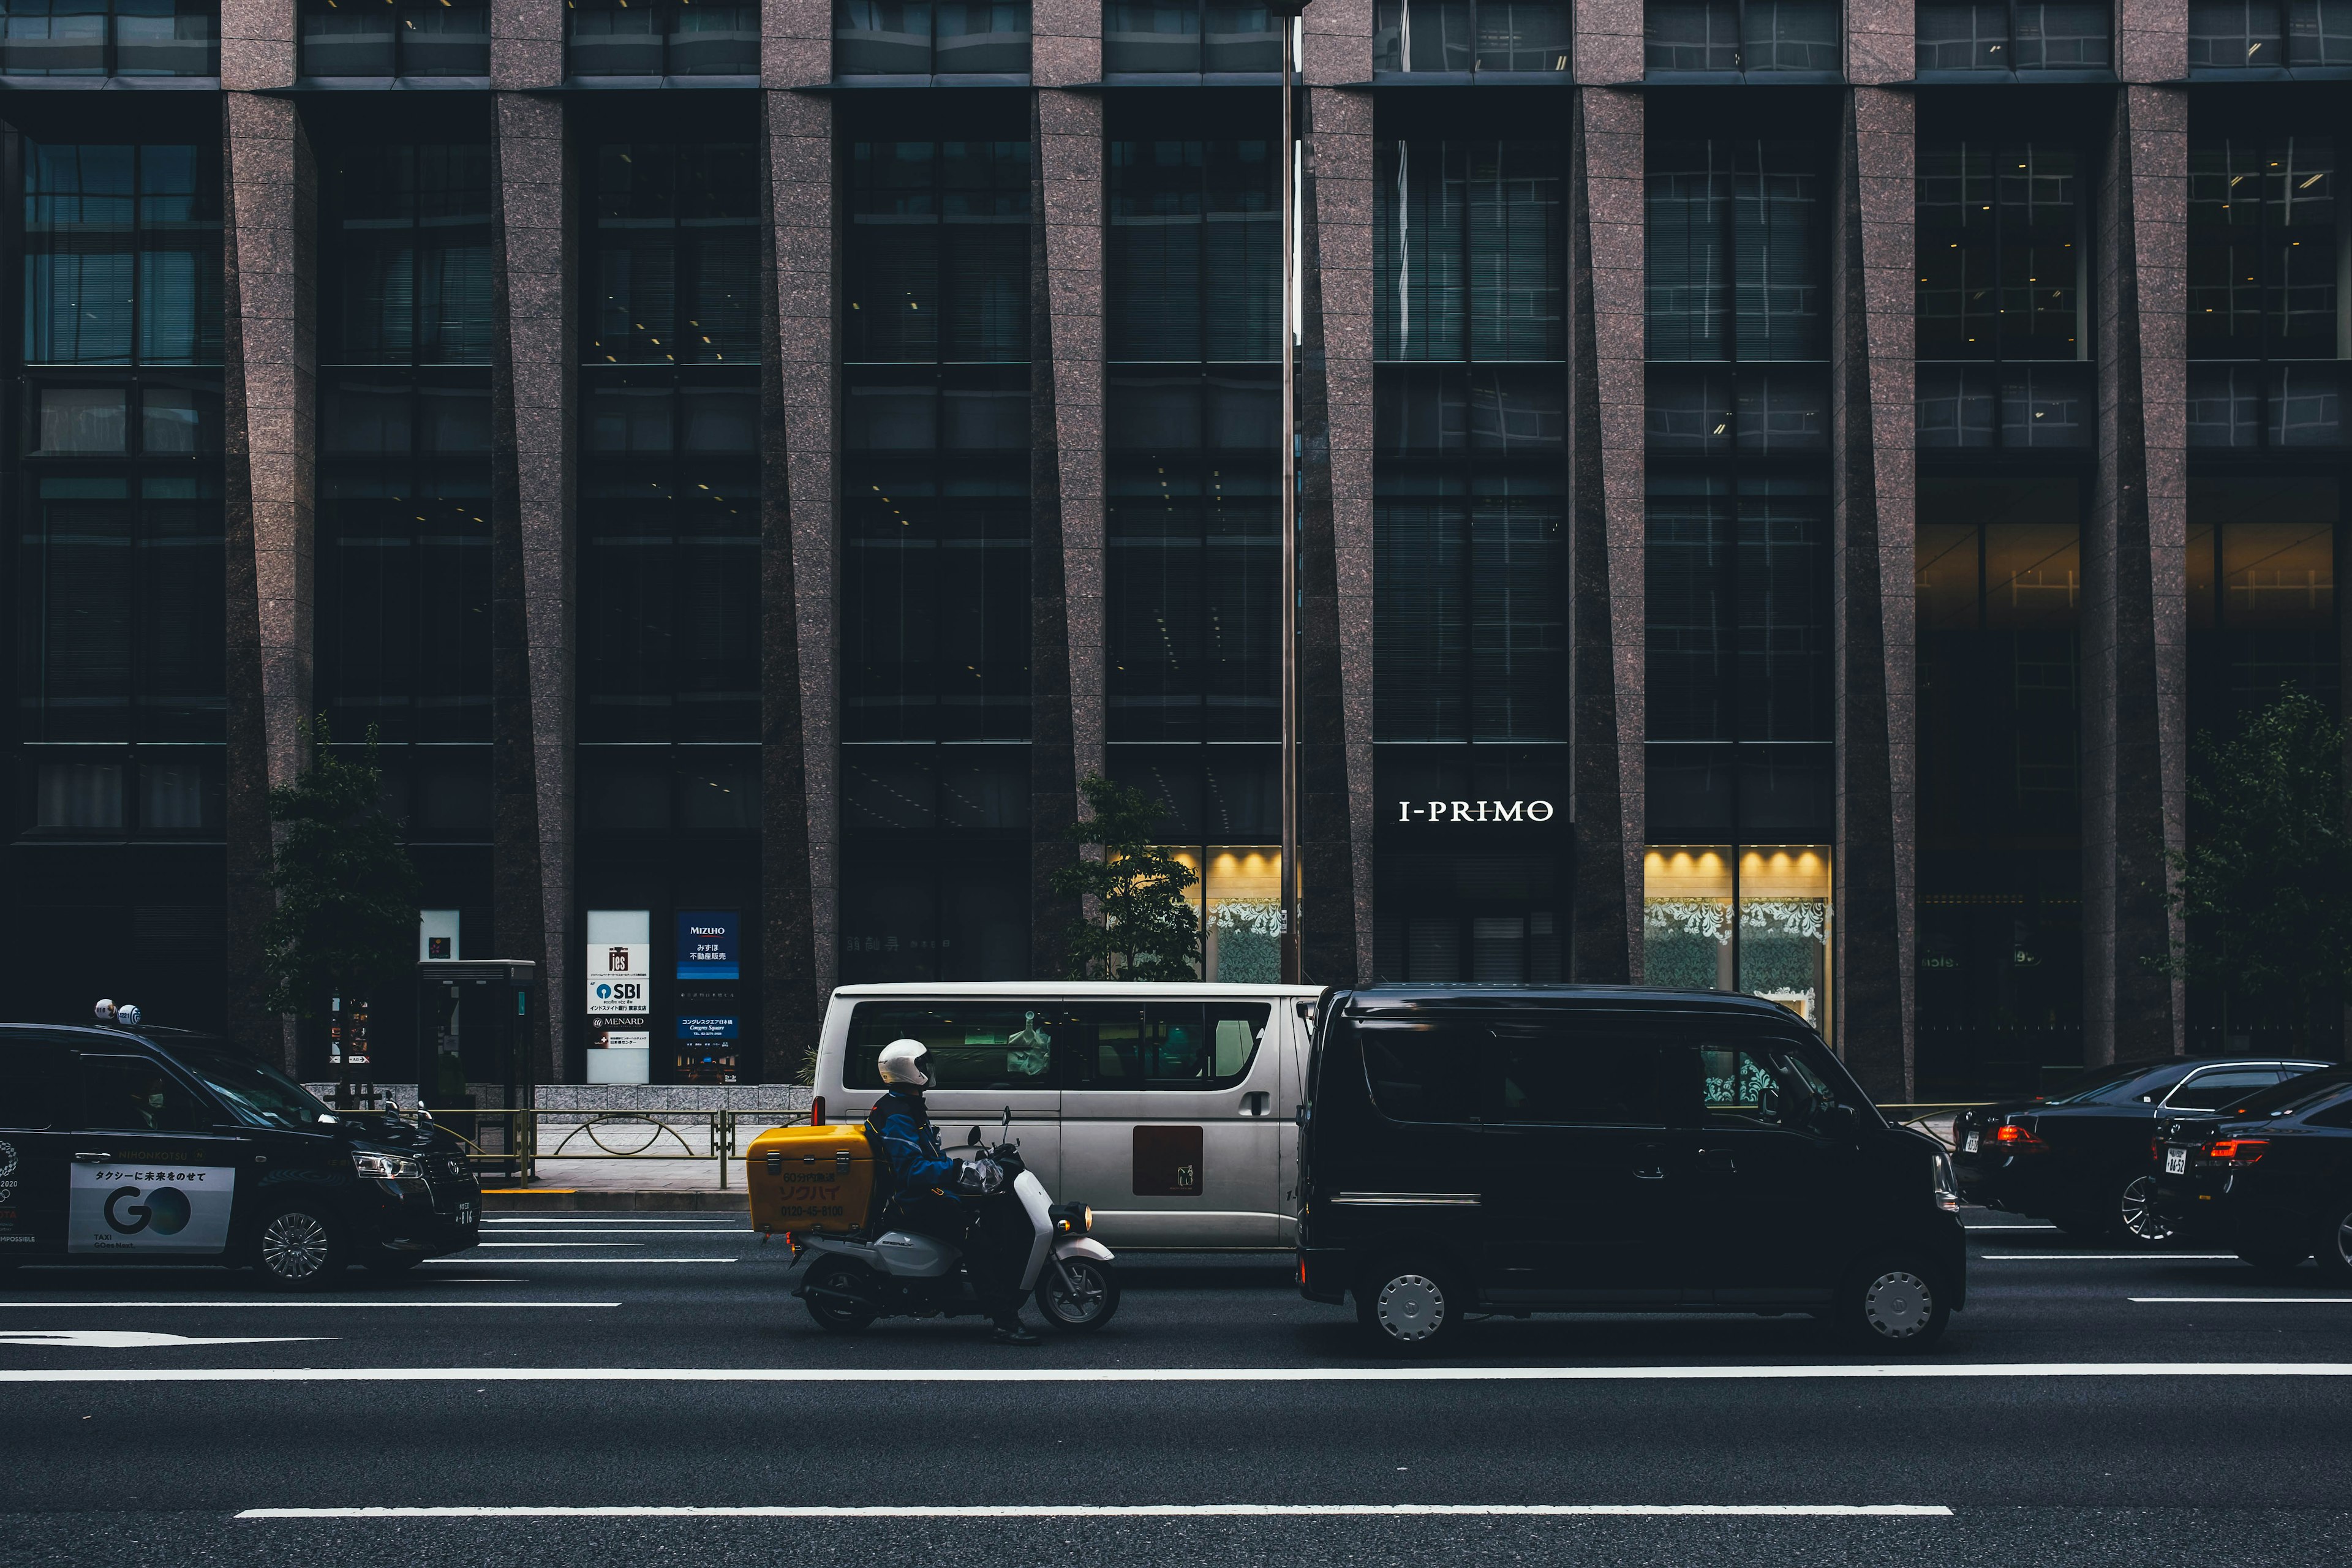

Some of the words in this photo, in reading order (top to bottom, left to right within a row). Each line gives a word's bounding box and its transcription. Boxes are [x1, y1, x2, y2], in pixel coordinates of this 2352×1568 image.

[1399, 801, 1553, 822] I-PRIMO
[611, 953, 625, 971] jes
[614, 984, 640, 999] SBI
[118, 1151, 187, 1161] NIHONKOTSU
[2169, 1158, 2184, 1172] 86-52
[96, 1170, 206, 1182] タクシーに未来をのせて
[783, 1173, 835, 1182] 60分内急送
[780, 1186, 841, 1201] ソクハイ
[104, 1186, 192, 1235] GO
[782, 1206, 843, 1216] 0120-45-8100
